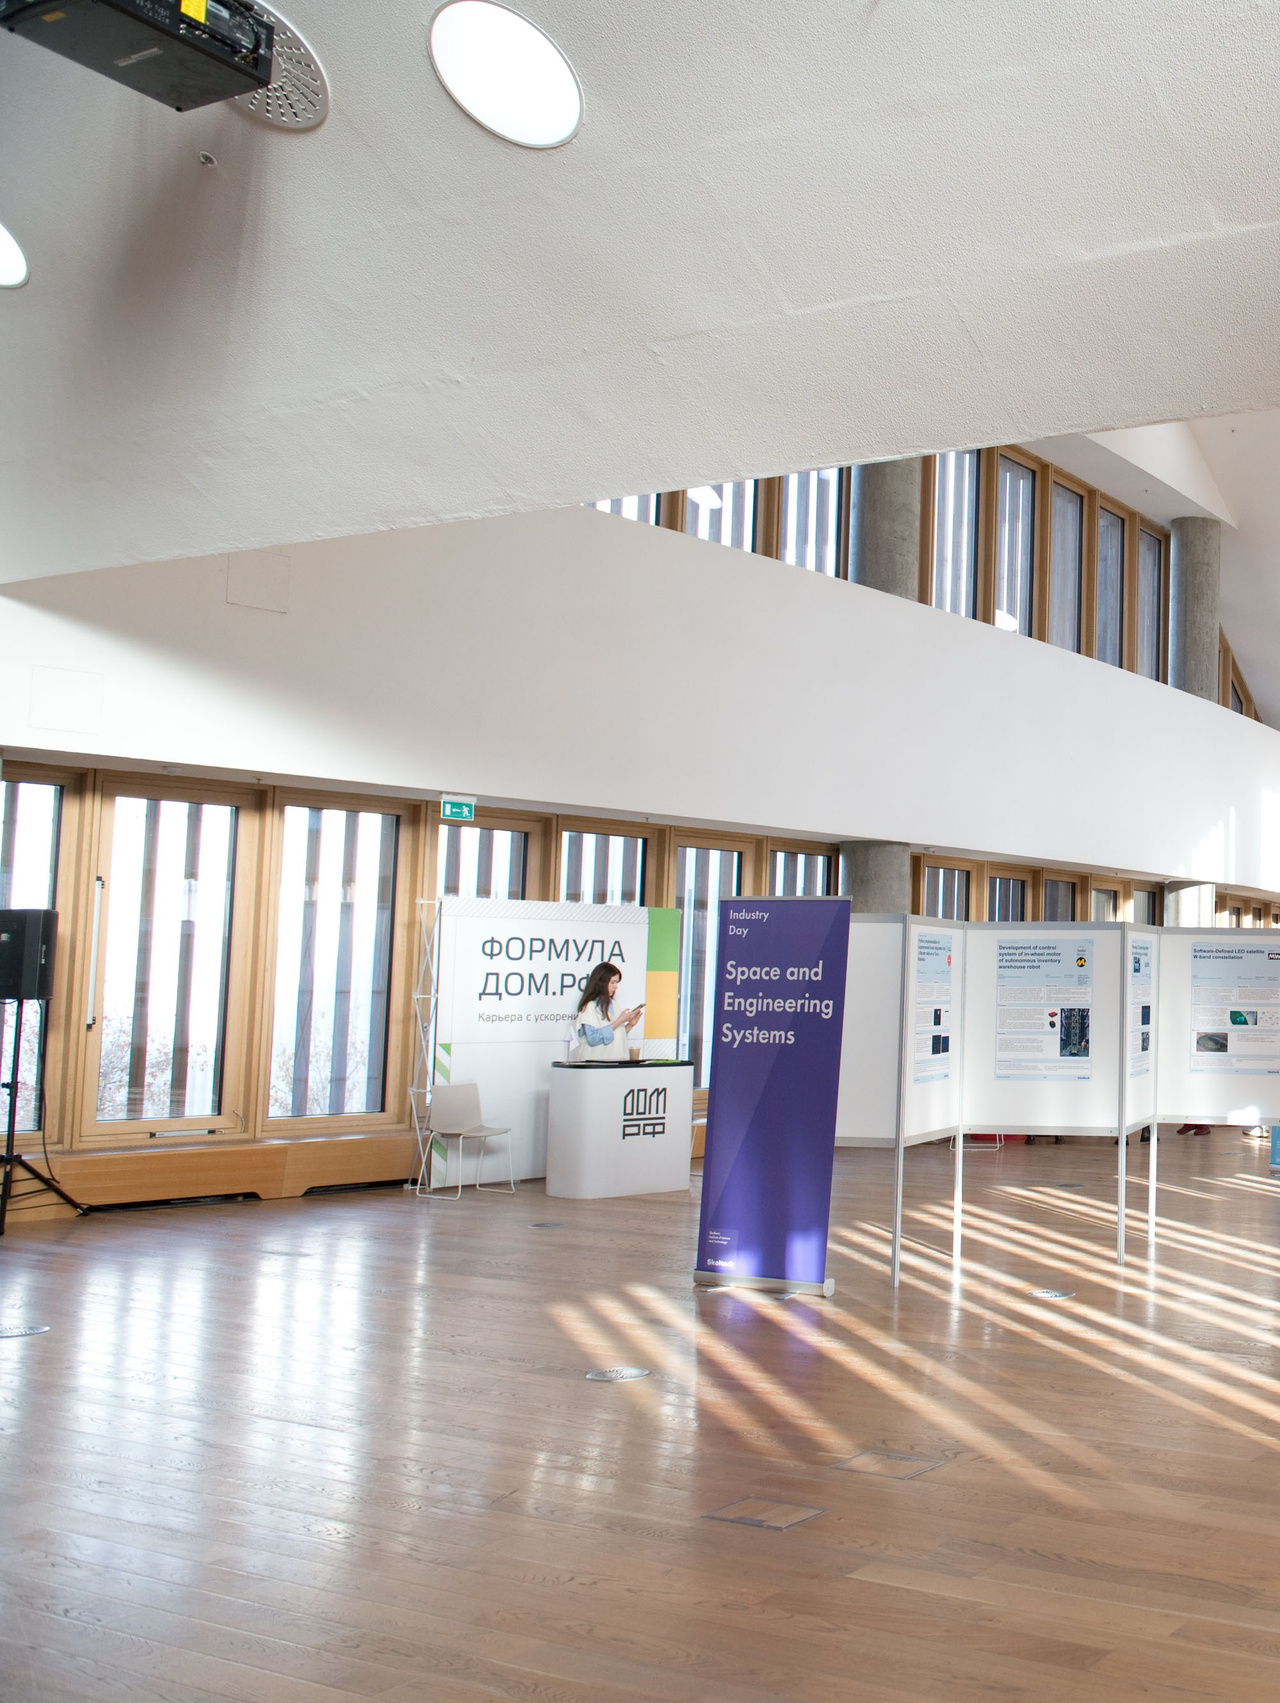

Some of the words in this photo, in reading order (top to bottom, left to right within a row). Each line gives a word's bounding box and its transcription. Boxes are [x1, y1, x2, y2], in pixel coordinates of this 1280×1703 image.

[729, 909, 769, 922] Industry
[728, 925, 749, 938] Day
[481, 937, 626, 963] ФОРМУЛА
[725, 960, 780, 985] Space
[786, 960, 823, 981] and
[723, 992, 833, 1019] Engineering
[478, 1013, 523, 1024] Карьера
[721, 1023, 795, 1048] Systems
[623, 1088, 667, 1116] ДОМ
[622, 1122, 666, 1140] РФ
